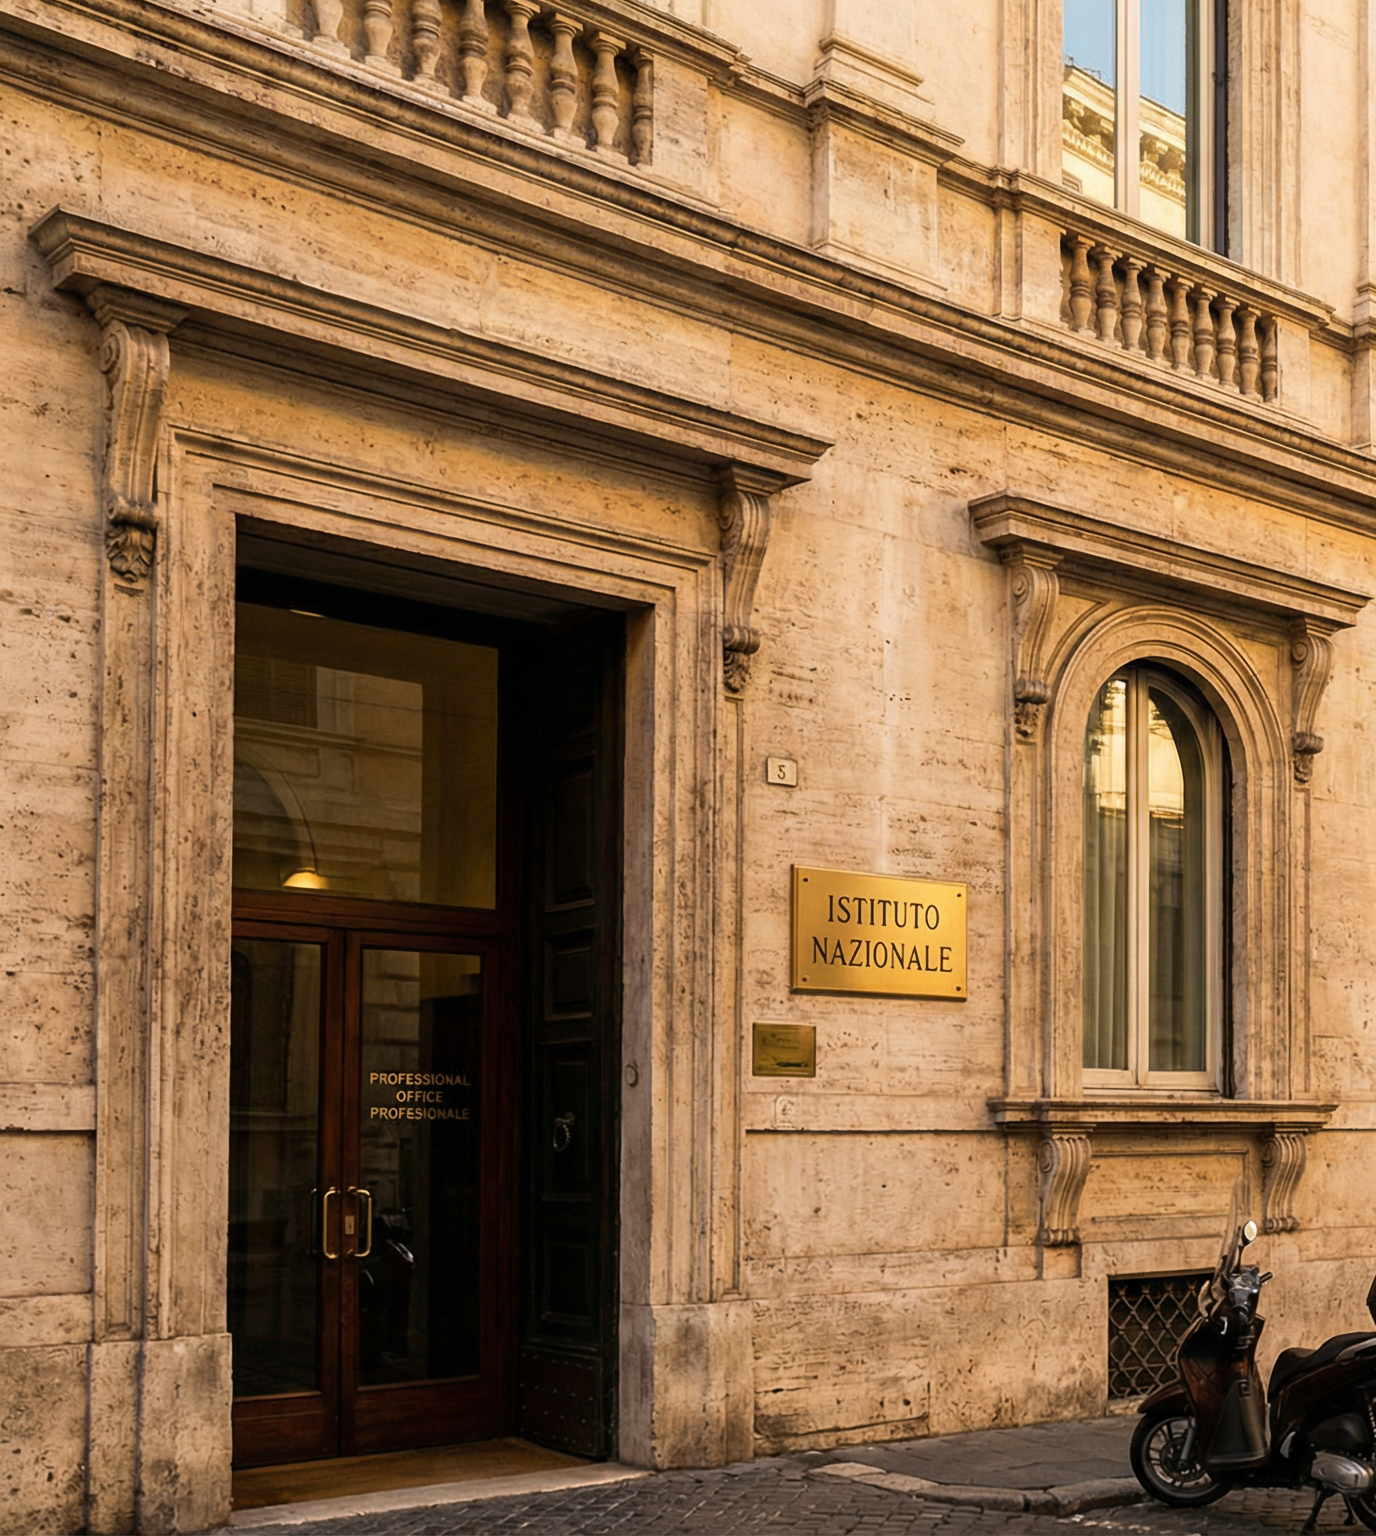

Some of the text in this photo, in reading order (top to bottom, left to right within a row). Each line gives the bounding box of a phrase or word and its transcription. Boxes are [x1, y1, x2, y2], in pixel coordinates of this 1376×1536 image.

[777, 764, 786, 780] 5
[828, 894, 940, 930] ISTITUTO
[812, 936, 953, 973] NAZIONALE
[369, 1072, 471, 1086] PROFESSIONAL
[395, 1090, 444, 1103] OFFICE
[370, 1107, 470, 1120] PROFESIONALE
